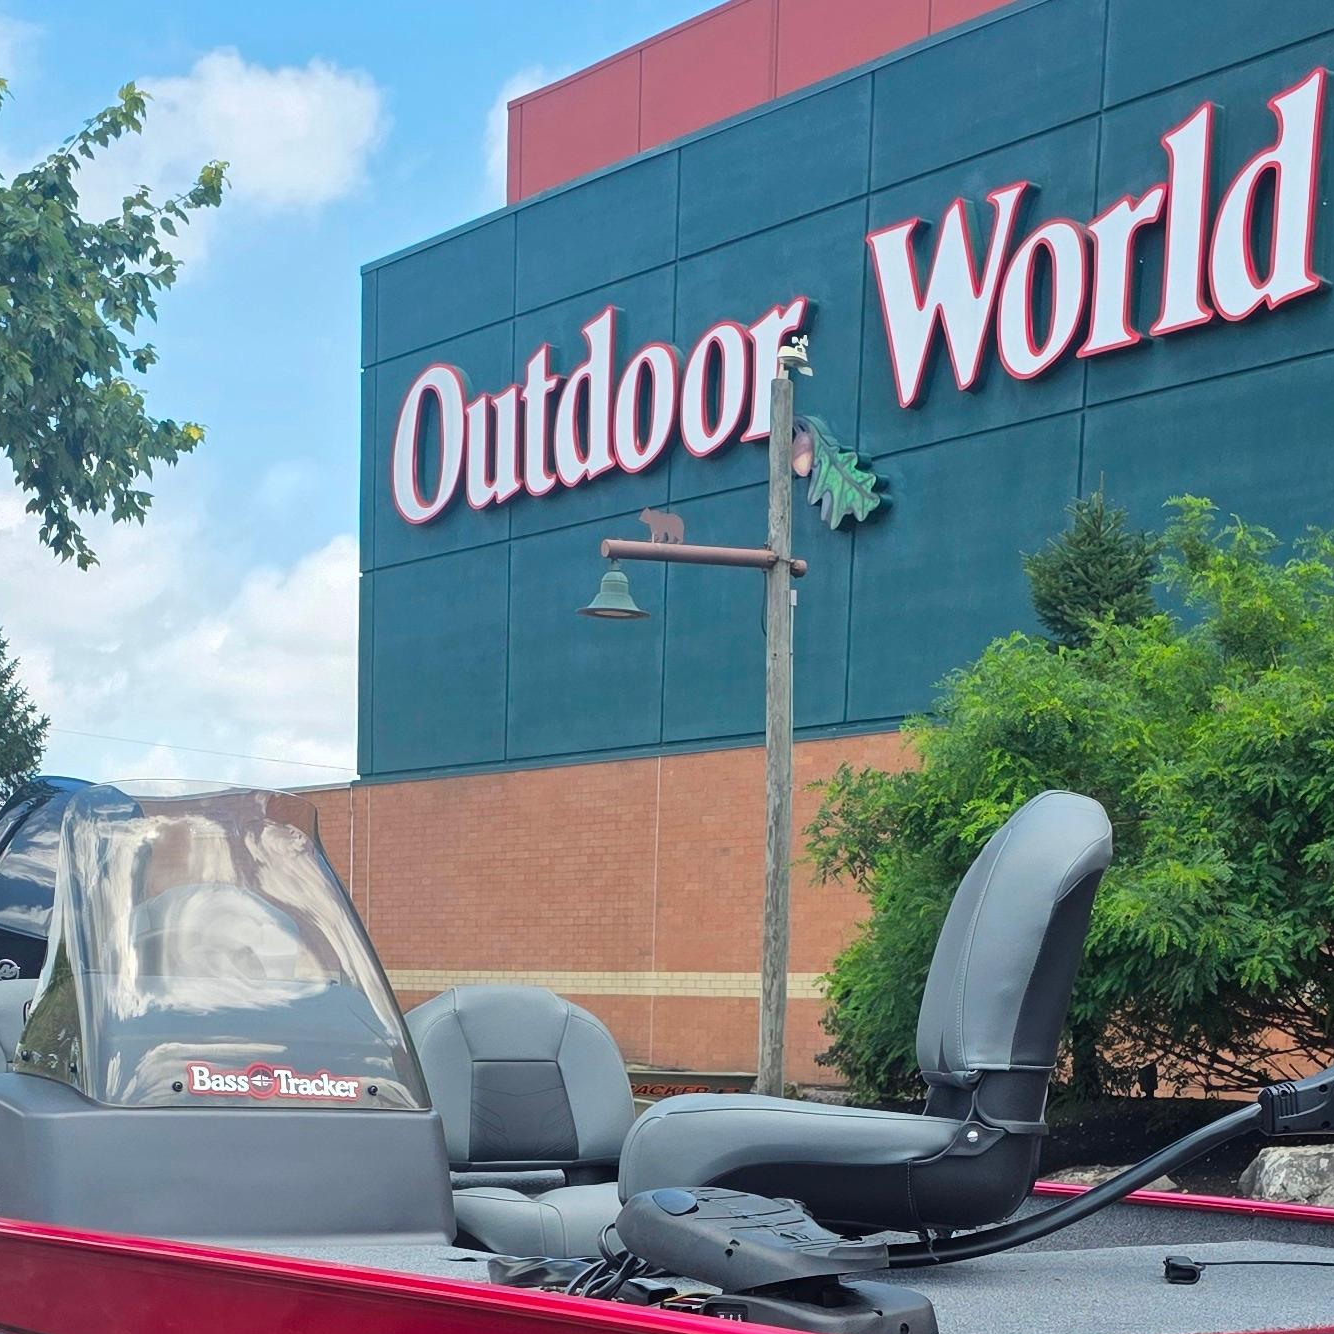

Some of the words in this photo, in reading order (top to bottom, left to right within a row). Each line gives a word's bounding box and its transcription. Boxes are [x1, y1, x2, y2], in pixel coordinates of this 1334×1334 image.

[392, 295, 809, 523] Outdoor
[867, 68, 1329, 407] World
[190, 1066, 250, 1092] Bass
[274, 1069, 359, 1098] Tracker
